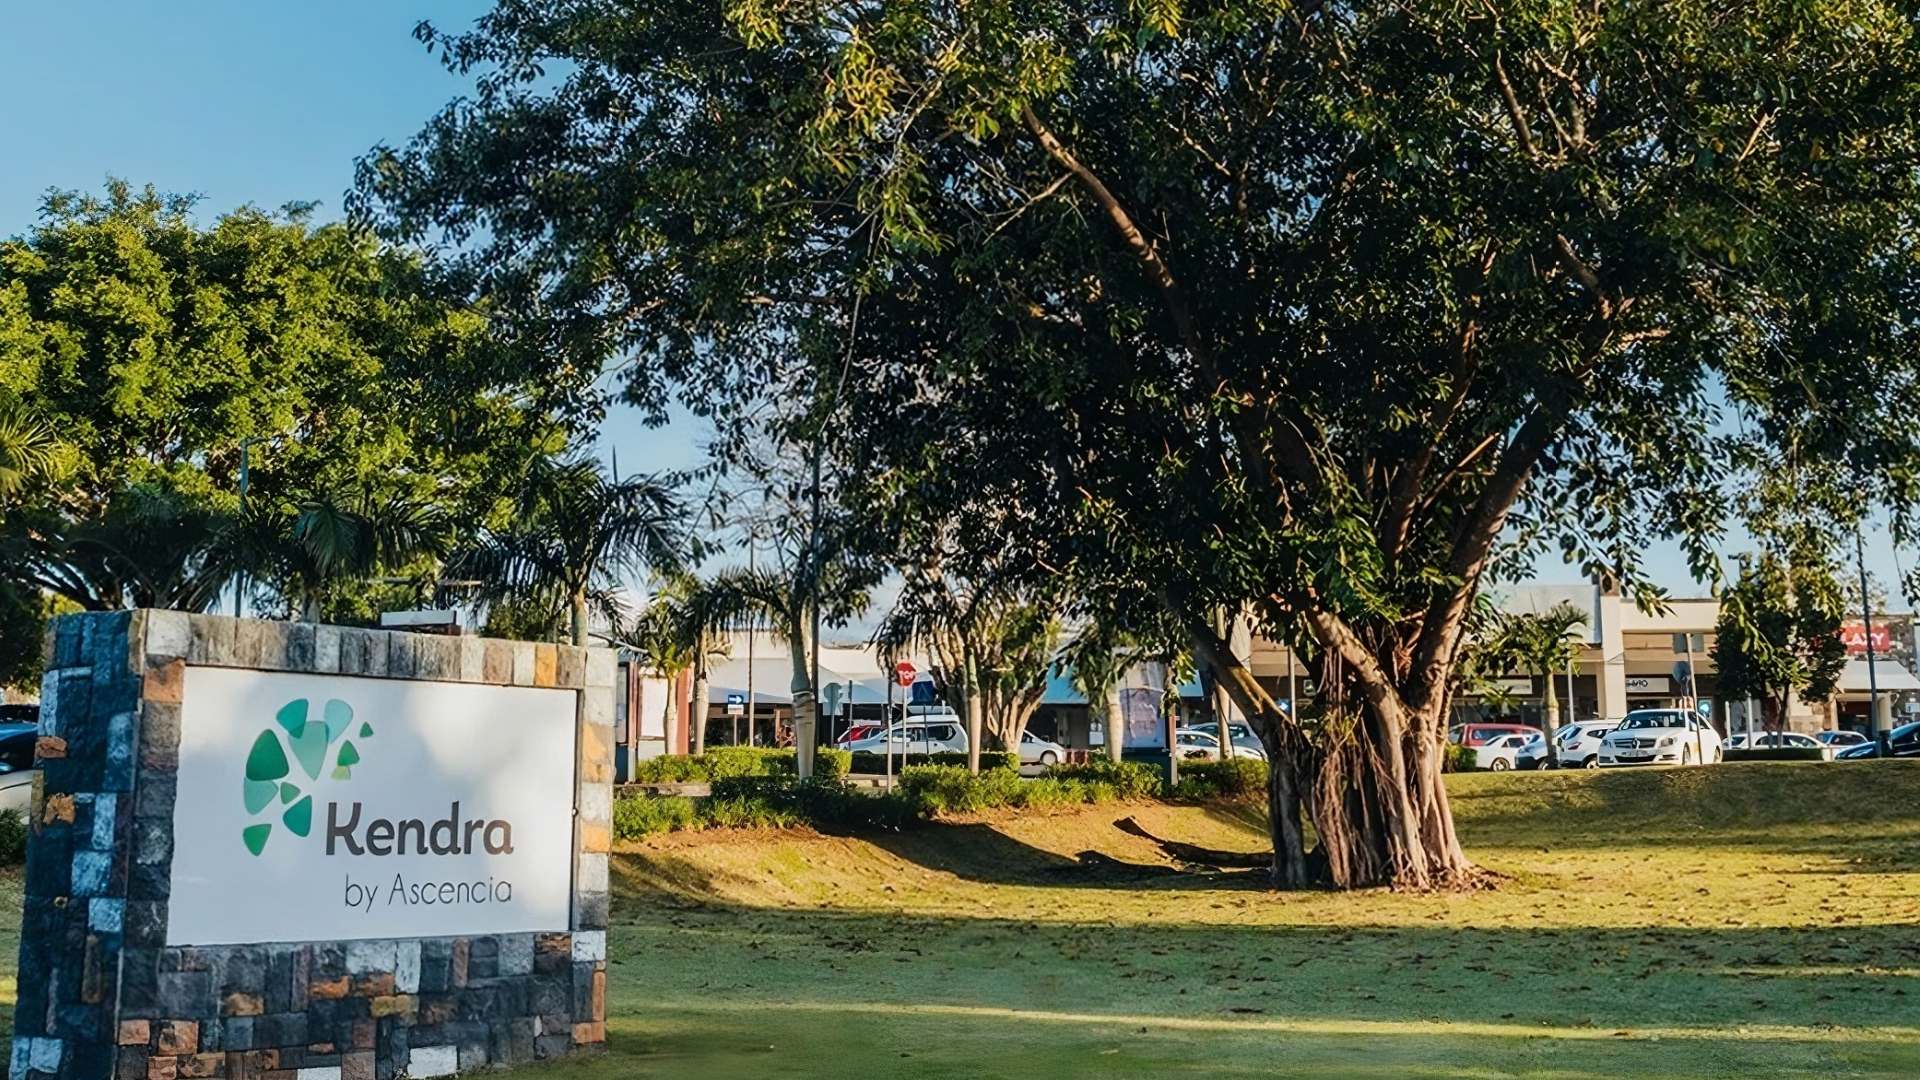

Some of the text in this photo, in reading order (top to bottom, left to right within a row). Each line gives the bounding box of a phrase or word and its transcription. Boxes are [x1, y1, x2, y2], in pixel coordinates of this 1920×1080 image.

[325, 800, 514, 856] Kendra
[345, 872, 512, 913] by Ascencia
